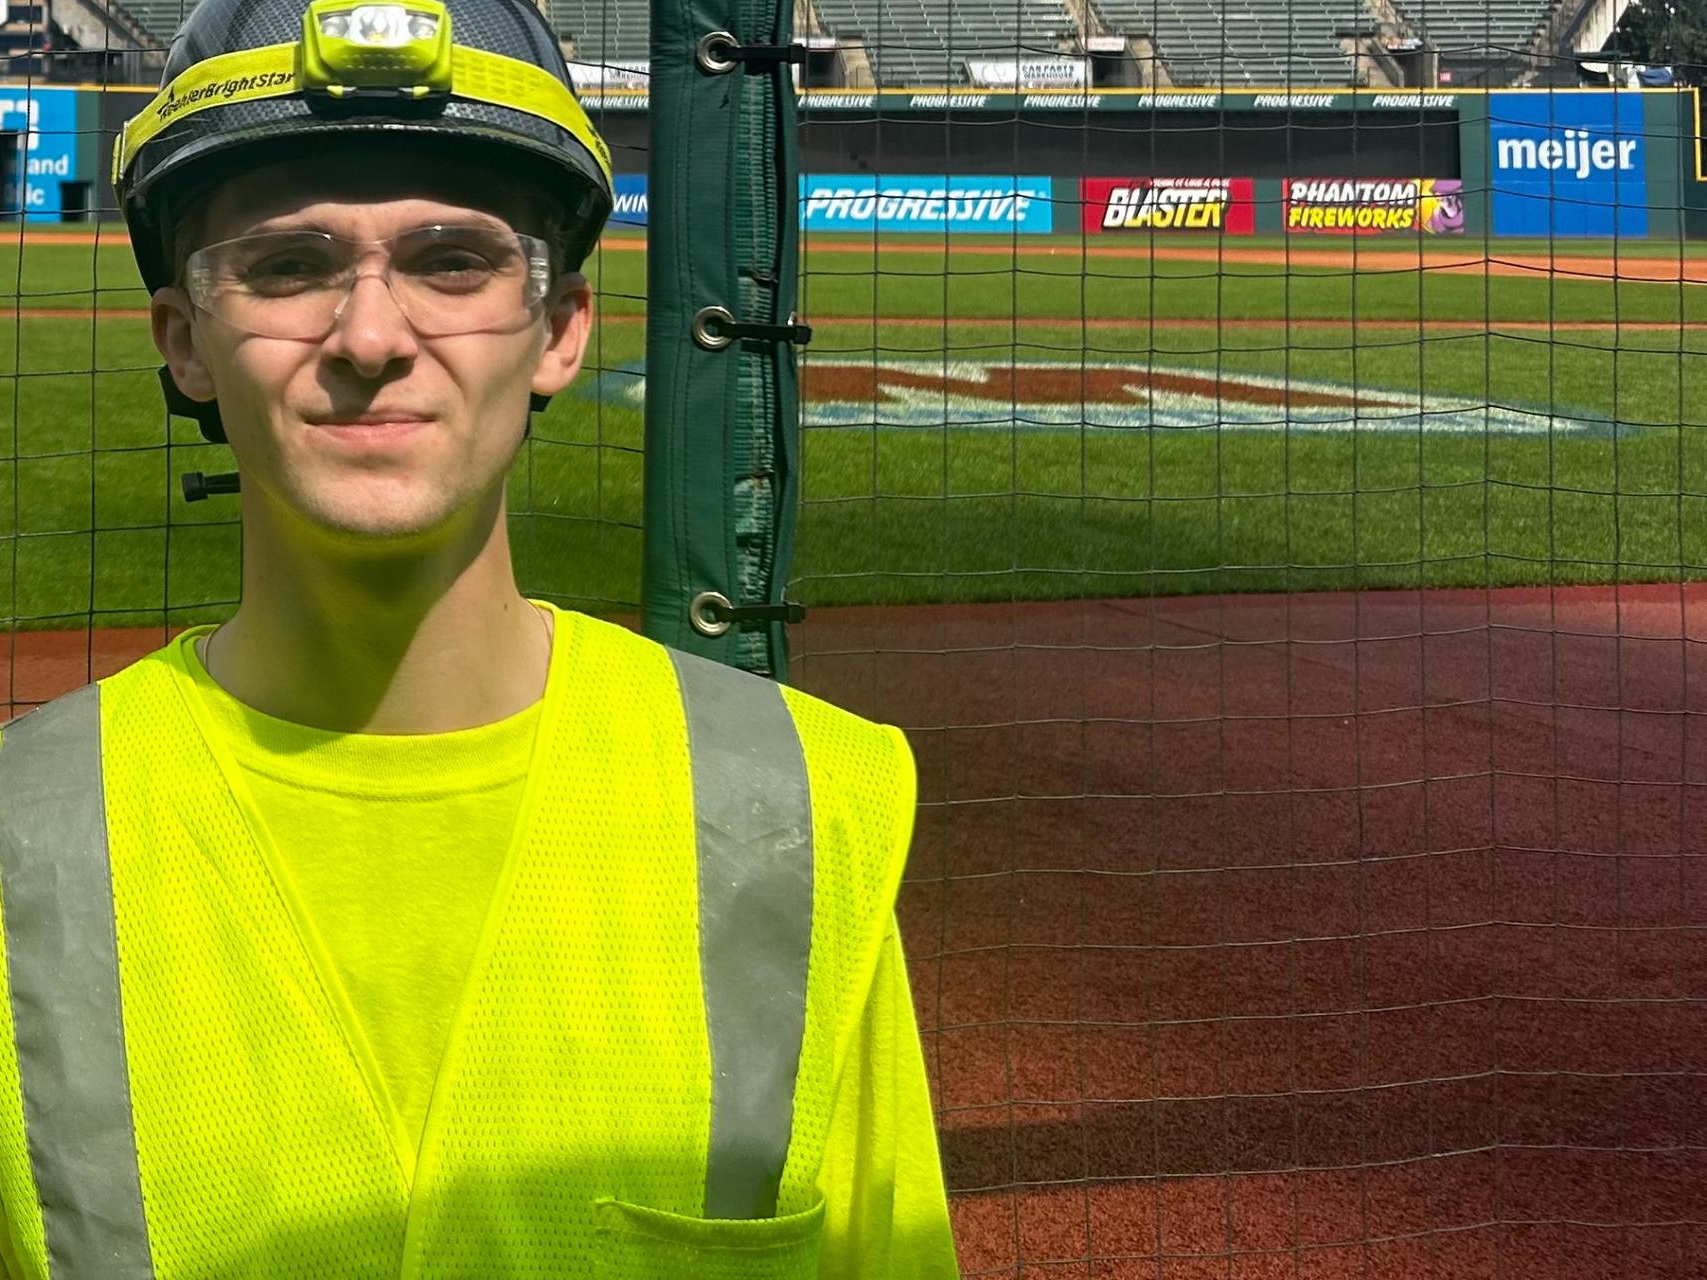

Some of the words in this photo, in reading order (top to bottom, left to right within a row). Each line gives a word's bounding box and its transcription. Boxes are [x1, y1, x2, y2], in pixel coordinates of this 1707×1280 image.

[798, 95, 873, 108] PROGRESSIVE
[910, 95, 987, 108] PROGRESSIVE
[1023, 95, 1102, 108] PROGRESSIVE
[1138, 95, 1216, 108] PROGRESSIVE
[1253, 95, 1334, 108] PROGRESSIVE
[1372, 95, 1454, 108] PROGRESSIVE
[1497, 128, 1637, 179] meijer
[1291, 182, 1416, 205] PHANTOM
[805, 188, 1035, 221] PROGRESSIVE
[1103, 187, 1228, 227] BLASTER
[1289, 206, 1414, 229] FIREWORKS
